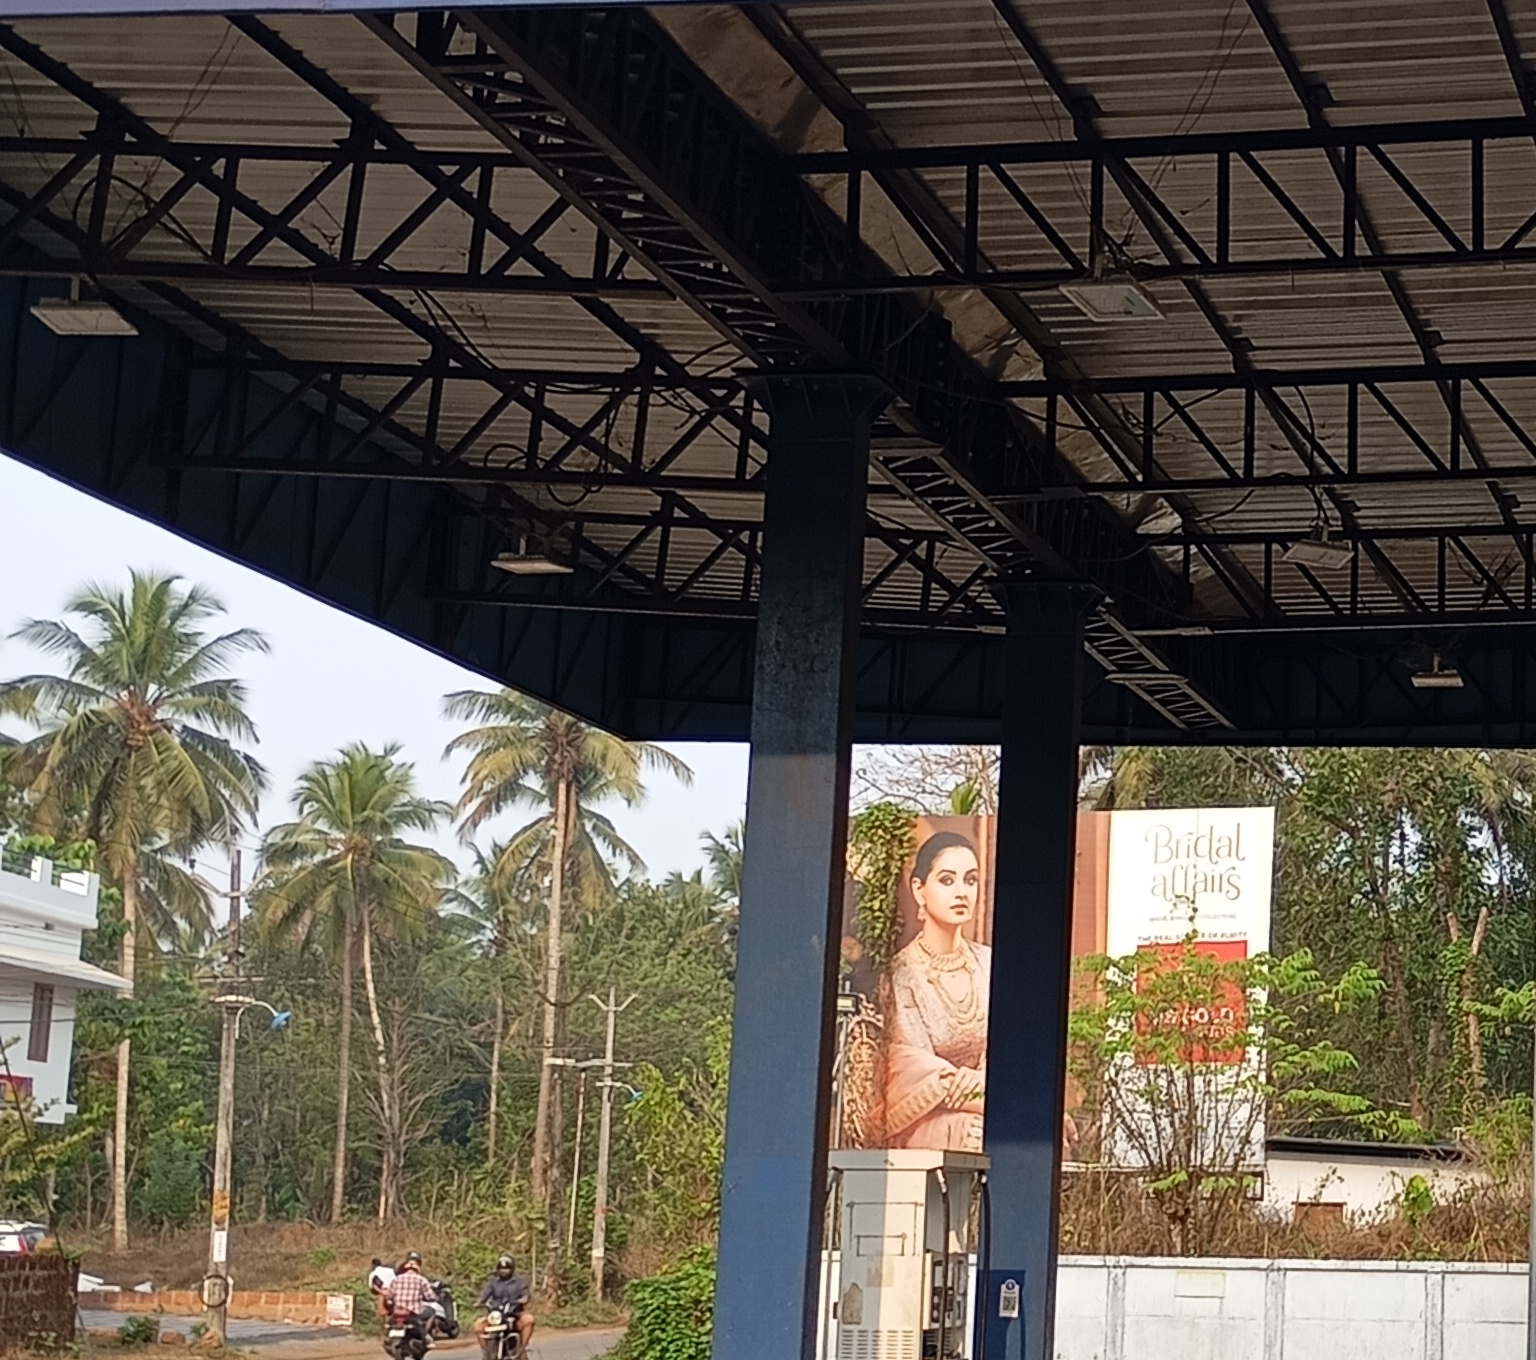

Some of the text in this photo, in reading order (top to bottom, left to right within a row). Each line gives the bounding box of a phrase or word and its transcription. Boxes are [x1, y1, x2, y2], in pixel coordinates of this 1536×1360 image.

[1144, 822, 1246, 865] Bridal
[1151, 863, 1241, 902] affairs
[1220, 931, 1248, 939] PURITY
